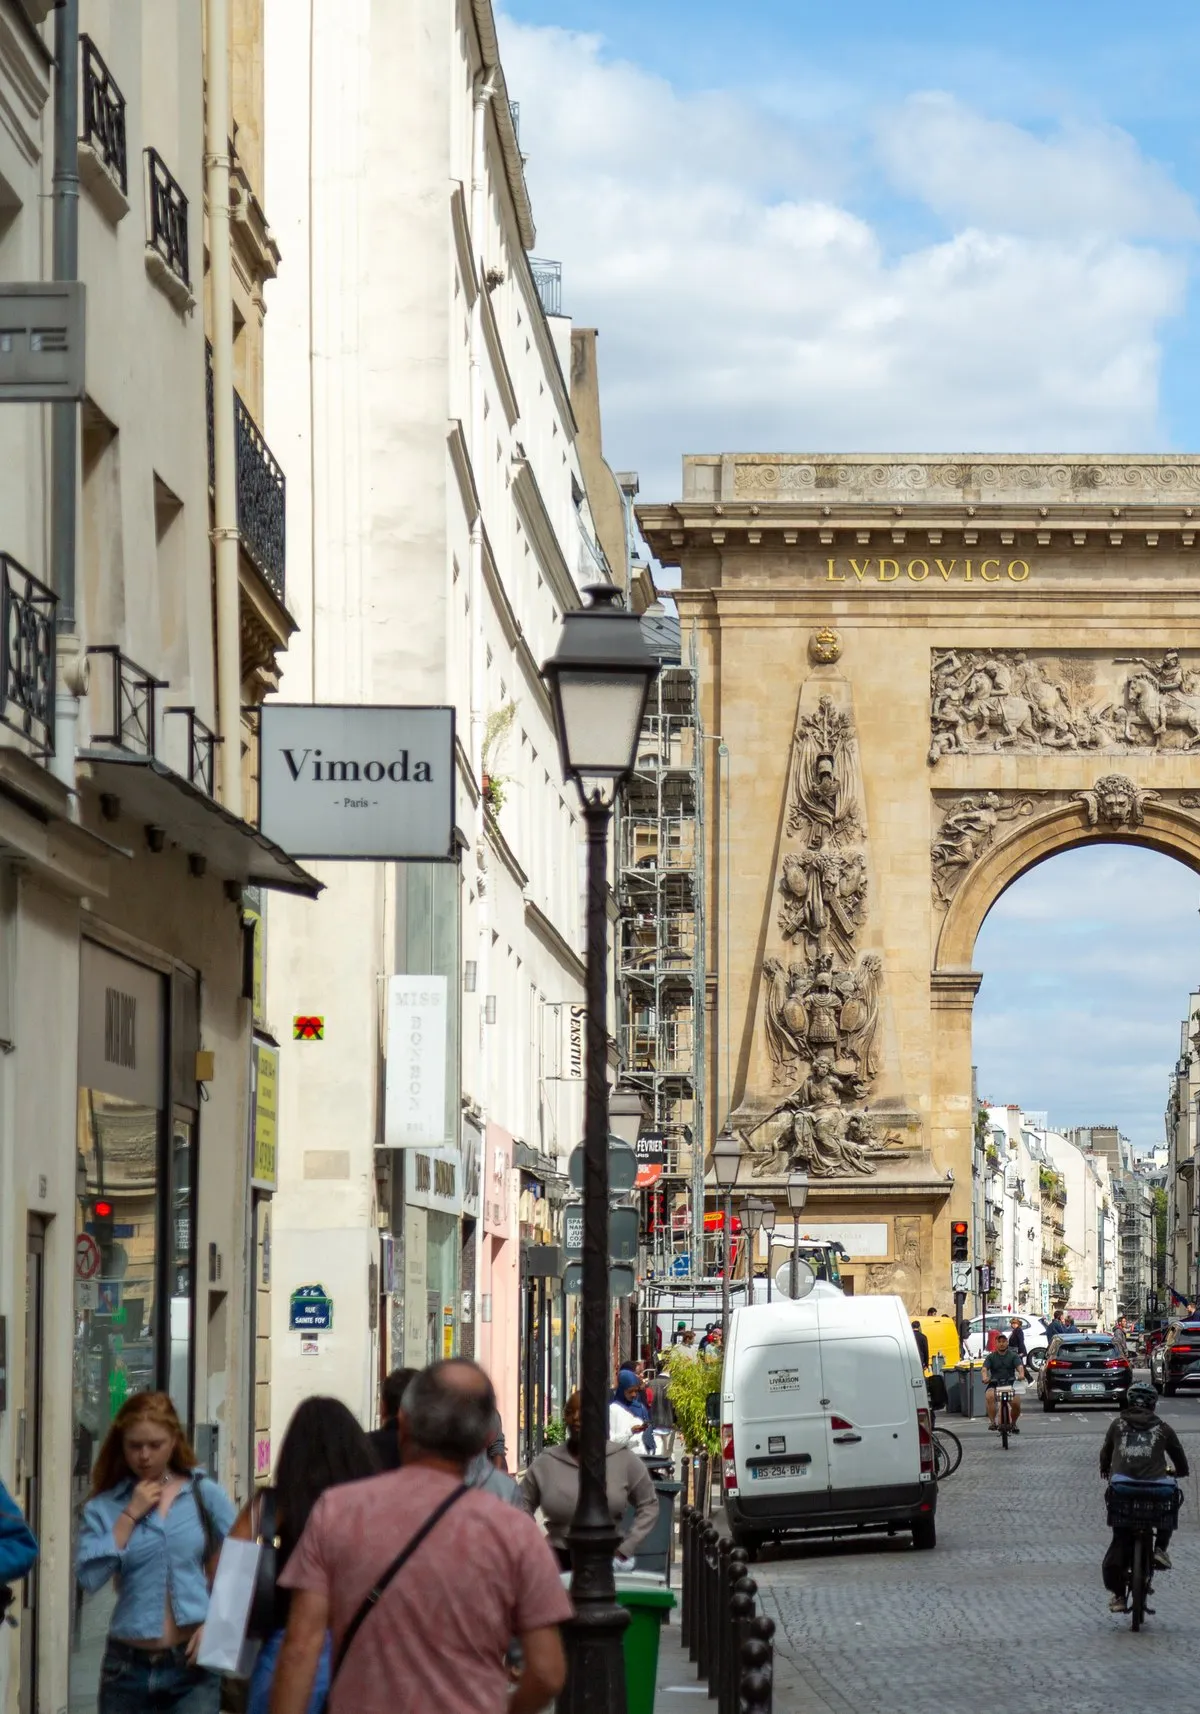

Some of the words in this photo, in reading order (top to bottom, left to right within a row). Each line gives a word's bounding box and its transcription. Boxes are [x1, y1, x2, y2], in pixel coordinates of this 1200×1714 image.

[826, 558, 1030, 582] LVDOVICO
[278, 748, 434, 783] Vimoda
[344, 798, 368, 808] Paris
[395, 992, 440, 1007] MISS
[570, 1005, 590, 1078] SENSITIVE
[637, 1138, 663, 1152] FÉVRIER
[305, 1306, 316, 1314] RUE
[770, 1377, 799, 1385] LIVRAISON
